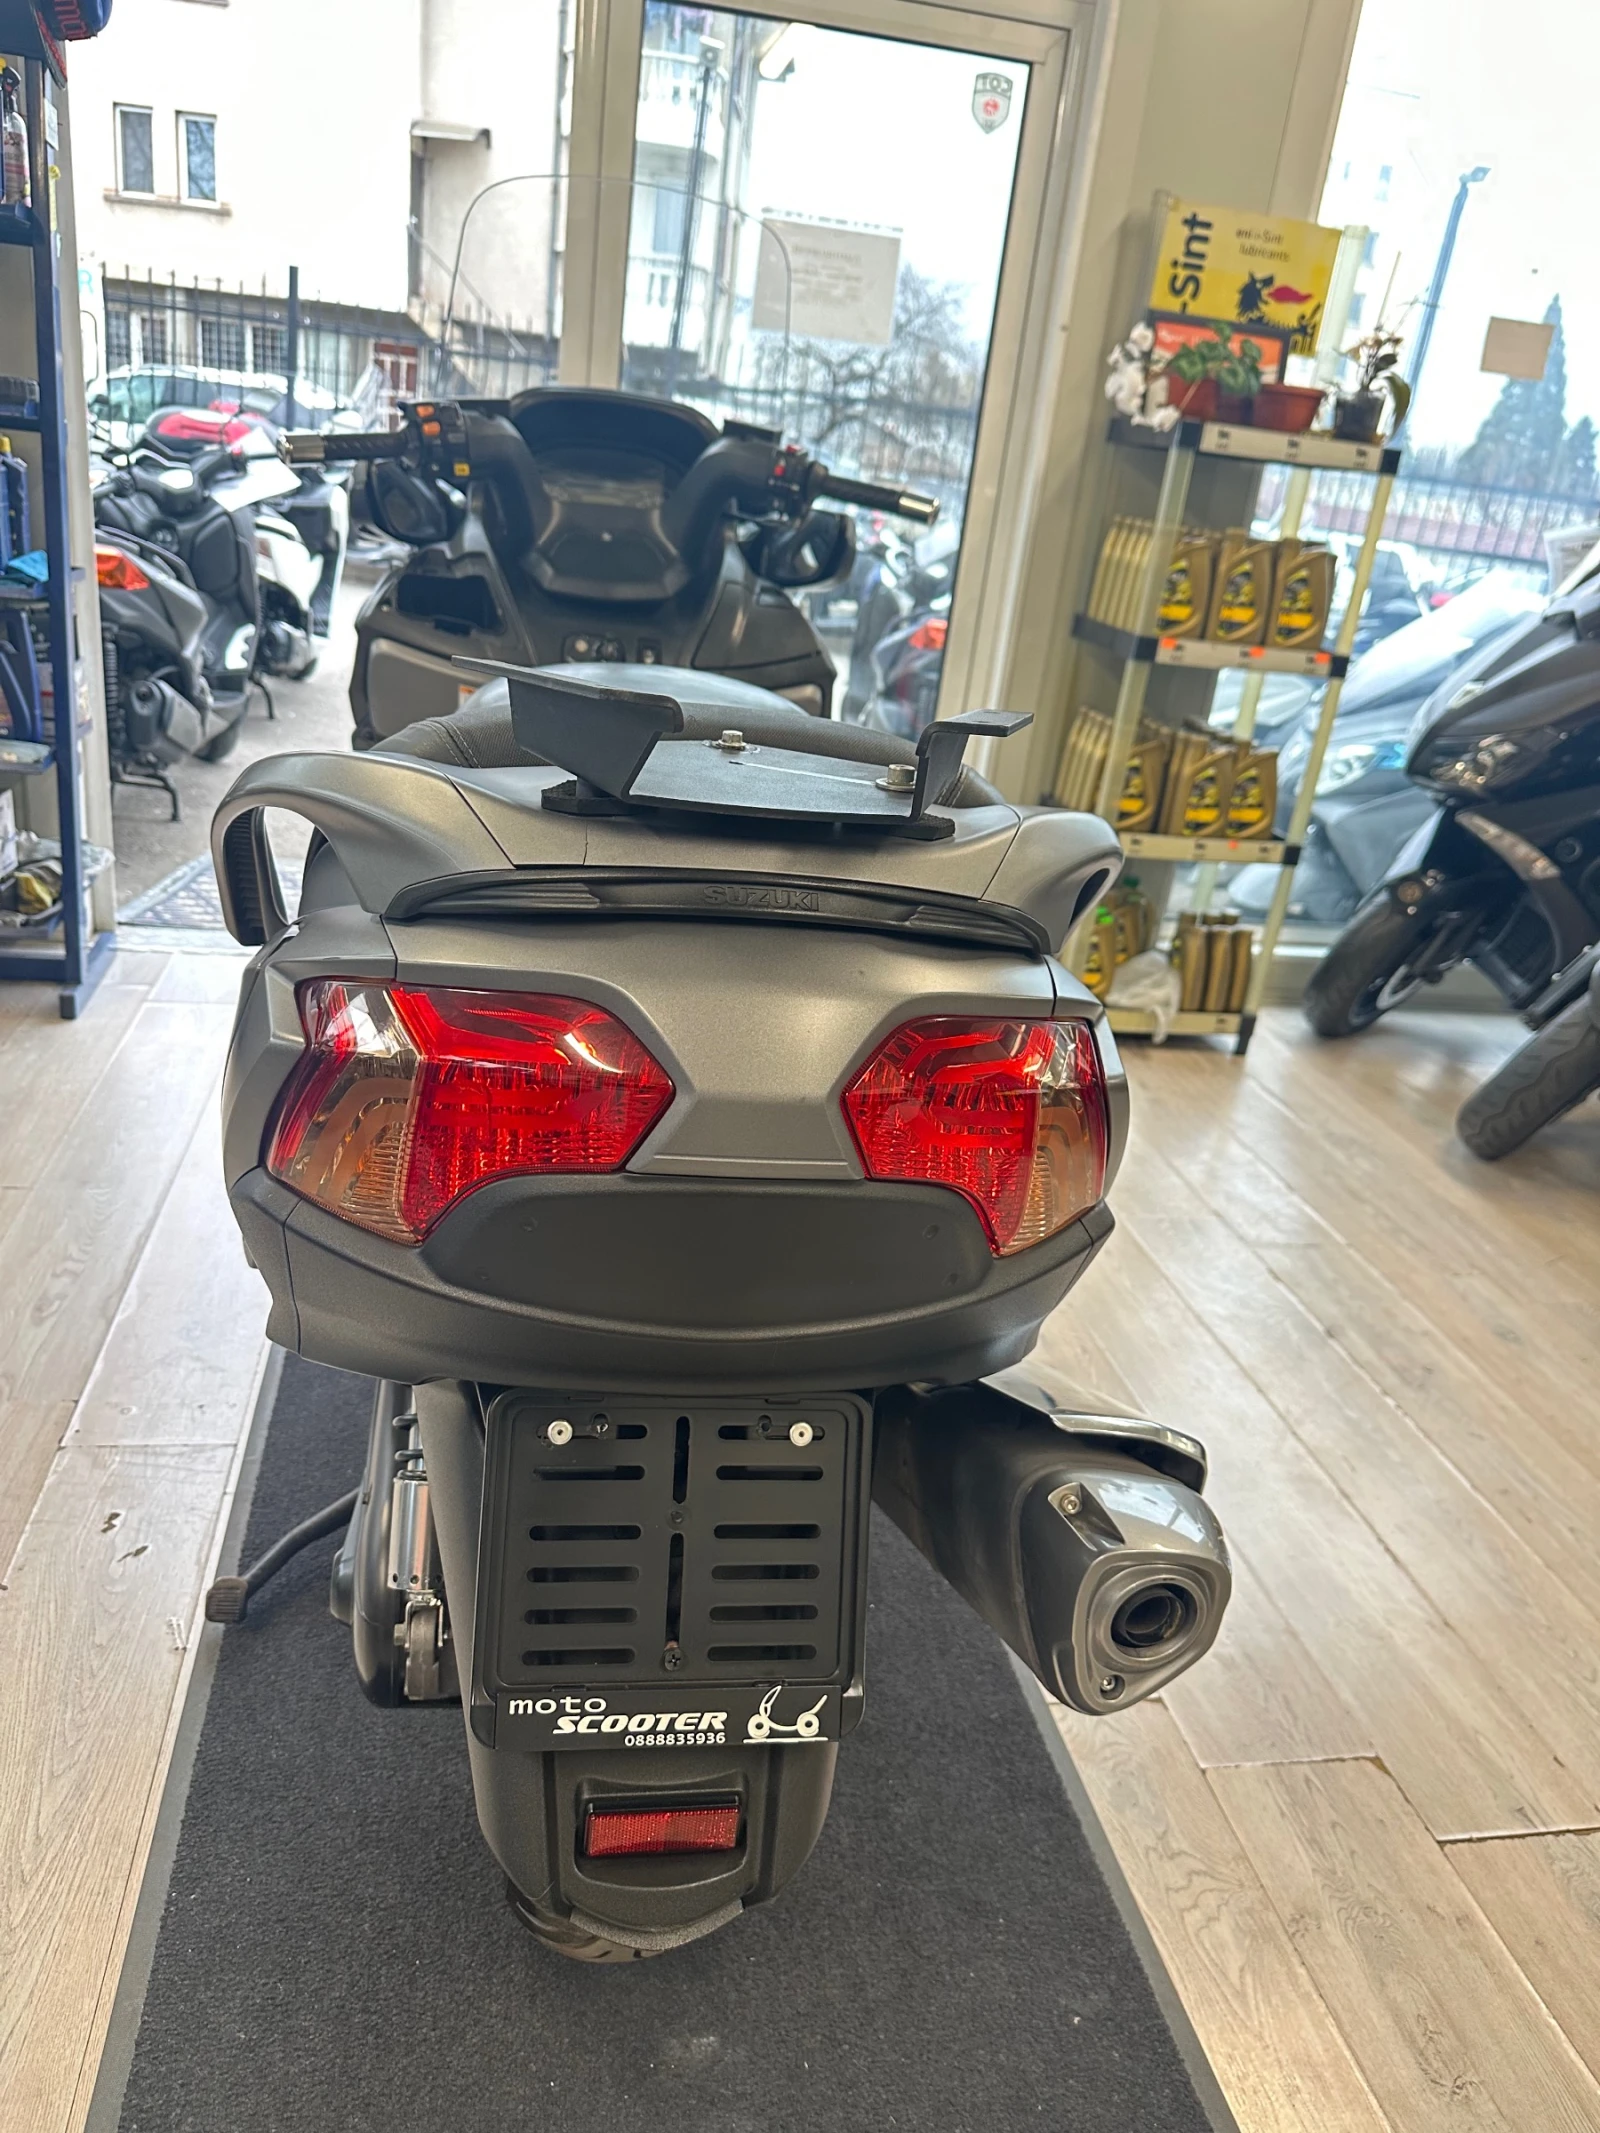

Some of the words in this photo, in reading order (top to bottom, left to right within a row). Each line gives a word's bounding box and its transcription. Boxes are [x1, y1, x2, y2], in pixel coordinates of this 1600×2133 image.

[703, 885, 819, 912] SUZUKI
[509, 1697, 607, 1715] moto
[553, 1711, 728, 1735] SCOOTER
[624, 1732, 726, 1747] 0888835936
